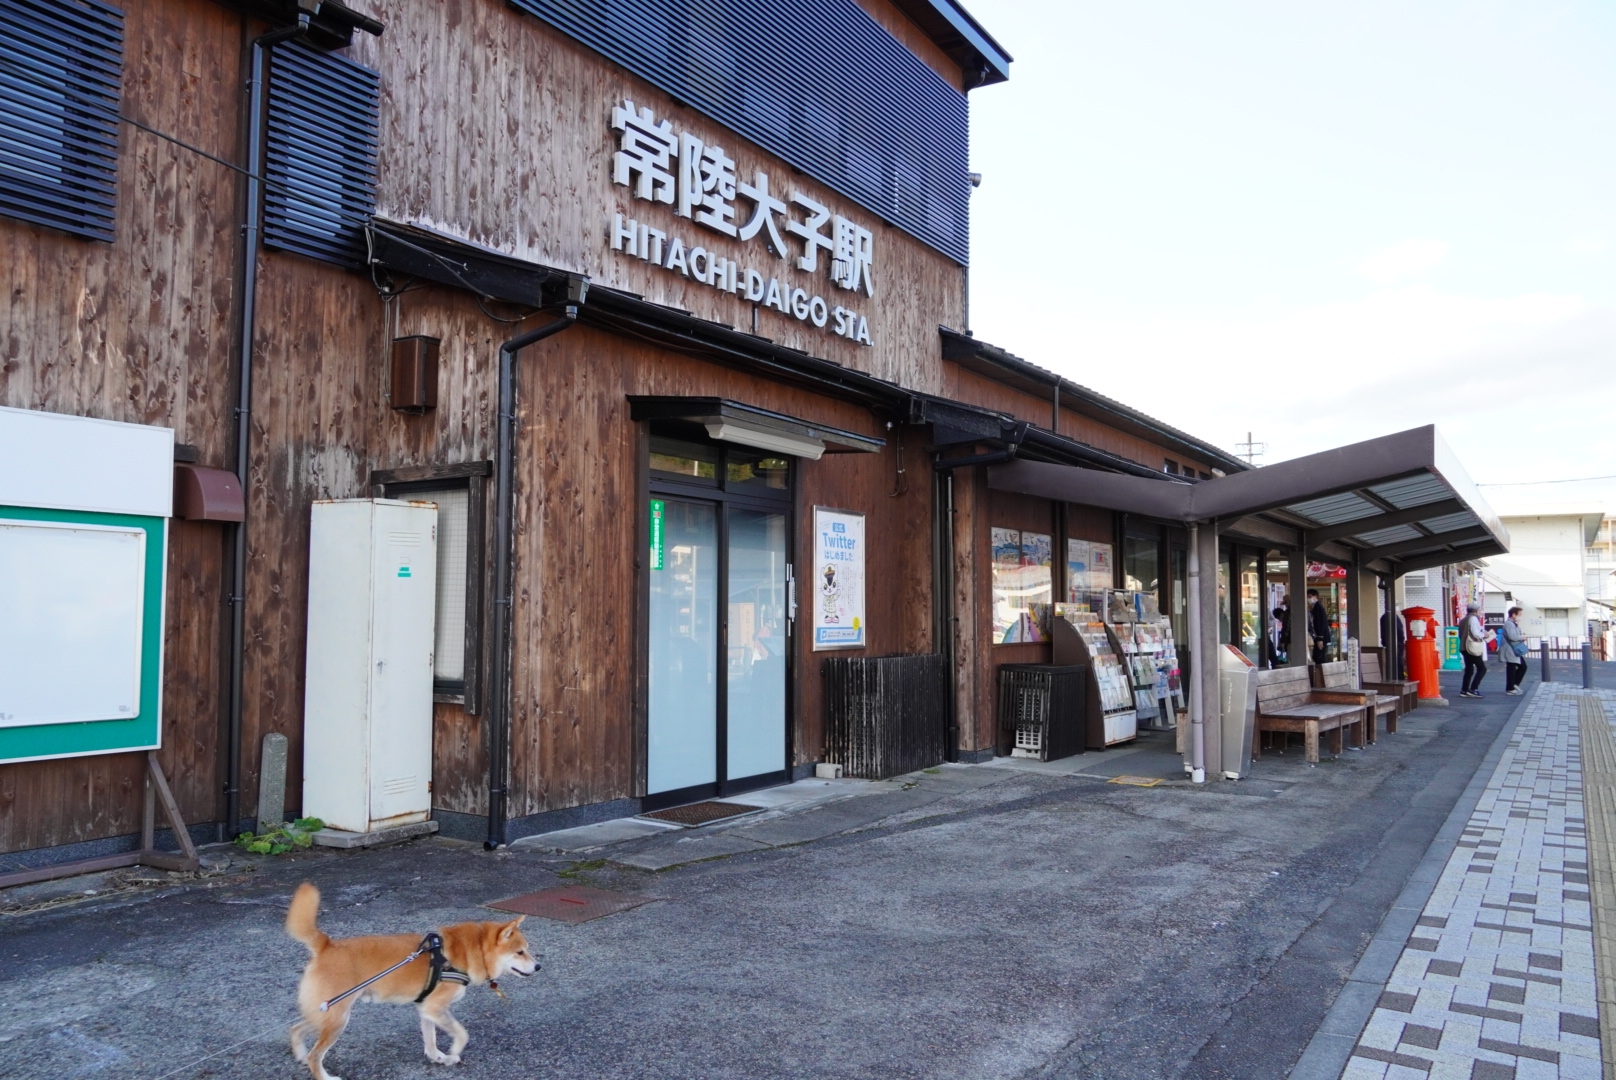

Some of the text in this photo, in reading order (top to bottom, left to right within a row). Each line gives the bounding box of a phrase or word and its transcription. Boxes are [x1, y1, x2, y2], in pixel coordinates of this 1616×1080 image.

[612, 100, 874, 298] 常陸大子駅
[610, 213, 875, 347] HITACHI-DAIGO STA.
[823, 532, 856, 549] Twitter
